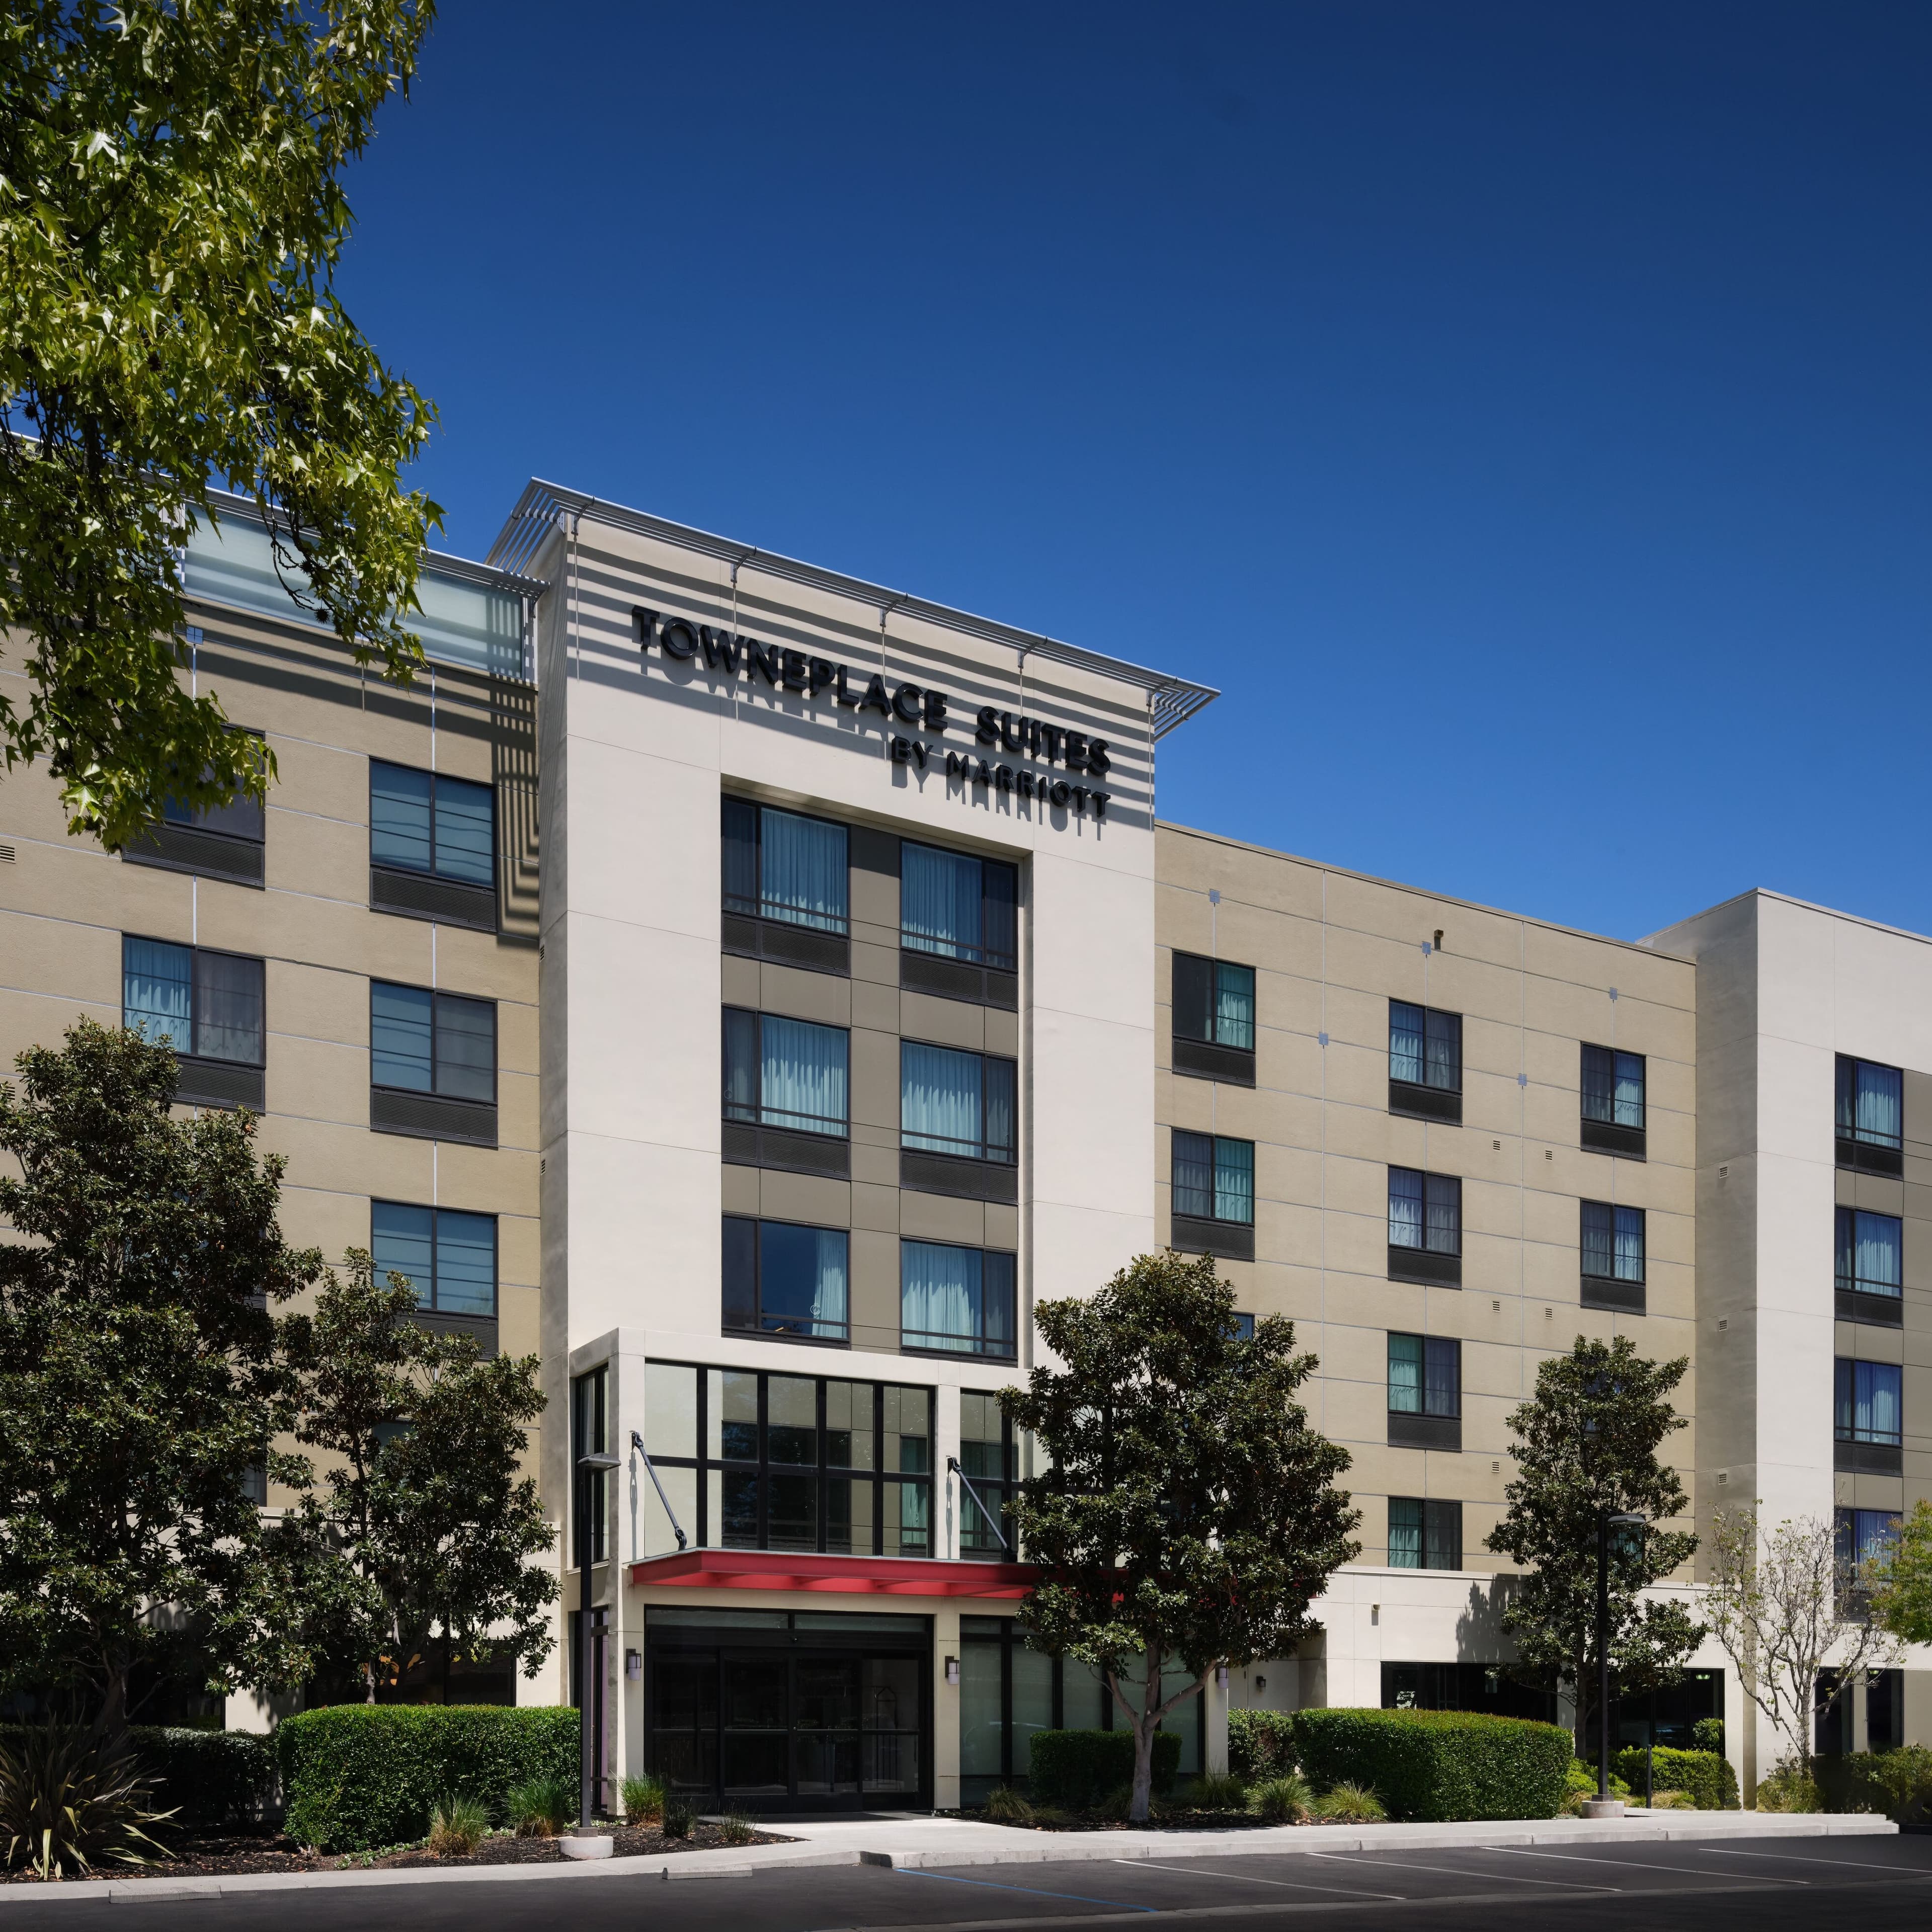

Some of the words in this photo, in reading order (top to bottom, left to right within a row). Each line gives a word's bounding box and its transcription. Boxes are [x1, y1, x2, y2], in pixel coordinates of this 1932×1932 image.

[632, 605, 948, 732] TOWNEPLACE
[975, 706, 1111, 776] SUITES
[891, 736, 934, 769] BY
[946, 751, 1111, 818] MARRIOTT
